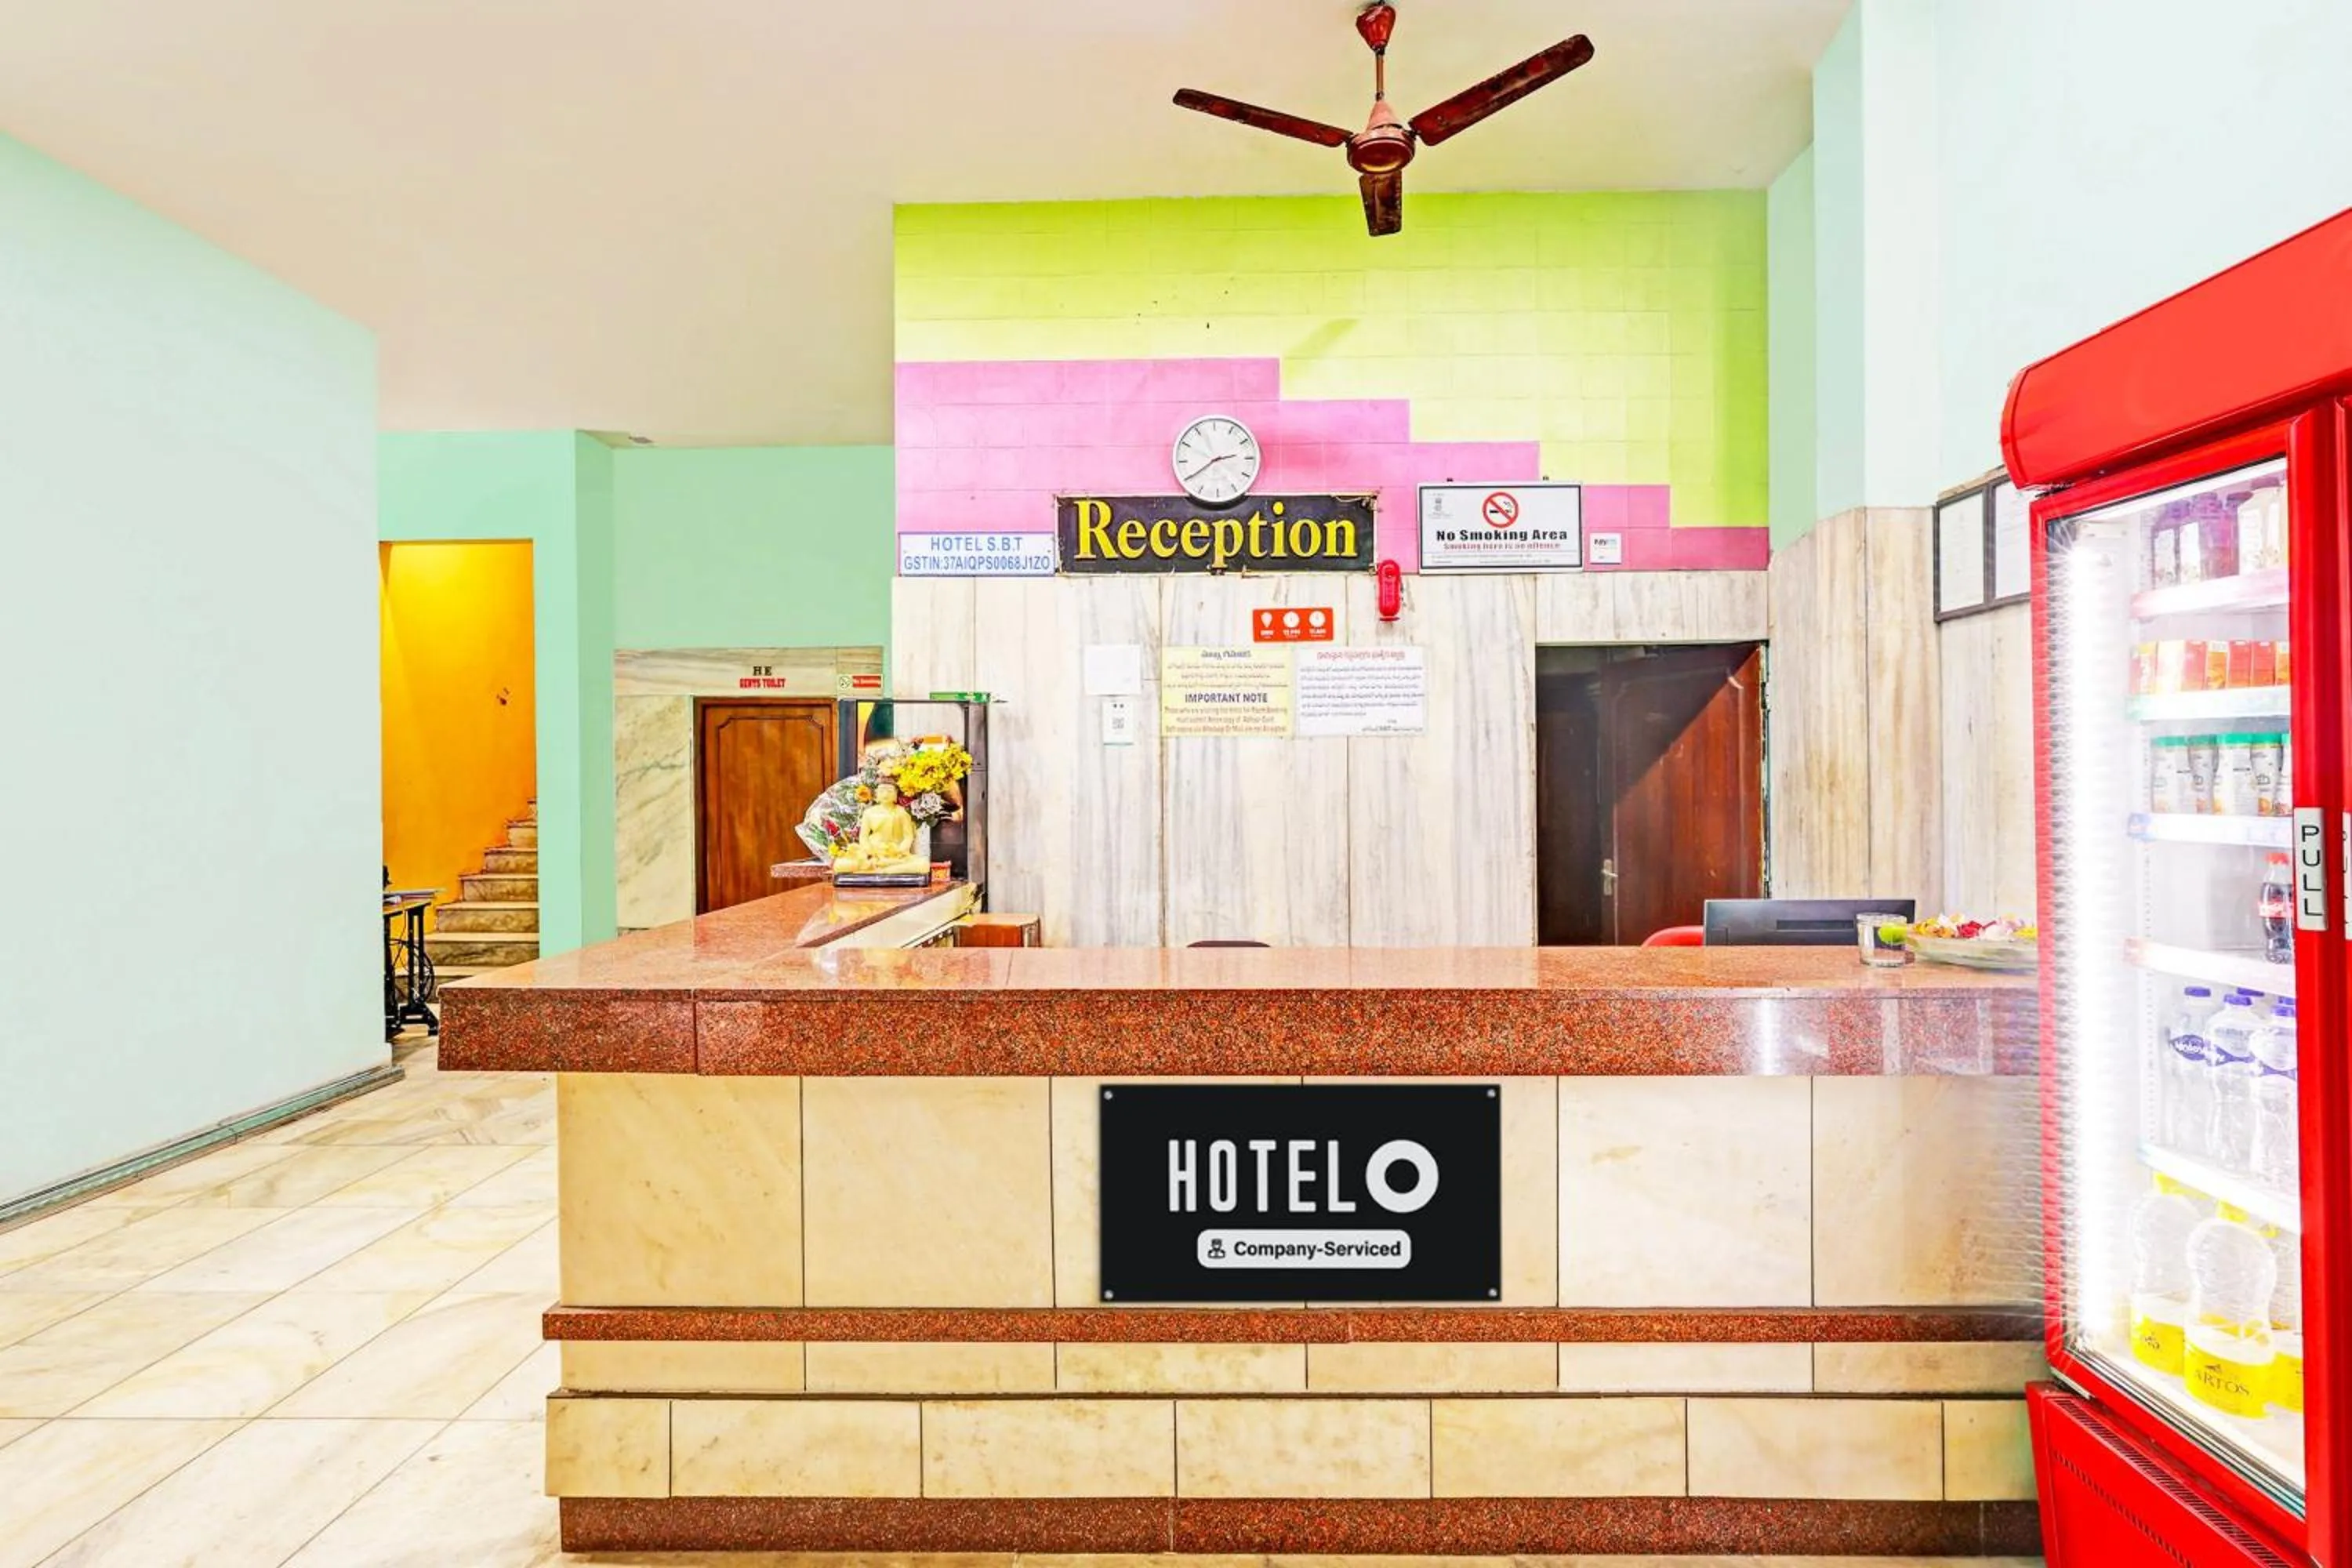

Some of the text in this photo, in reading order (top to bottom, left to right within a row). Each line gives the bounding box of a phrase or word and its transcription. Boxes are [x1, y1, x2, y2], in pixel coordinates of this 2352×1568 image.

[1072, 499, 1358, 568] Reception
[1436, 529, 1567, 542] No Smoking Area
[931, 536, 1022, 551] HOTEL S.B.T
[762, 678, 786, 688] TOILET
[1185, 692, 1268, 703] IMPORTANT NOTE
[2301, 825, 2323, 916] PULL
[1168, 1139, 1439, 1213] HOTEL O
[1233, 1241, 1402, 1260] Company-Serviced
[2195, 1370, 2250, 1396] ARTOS
